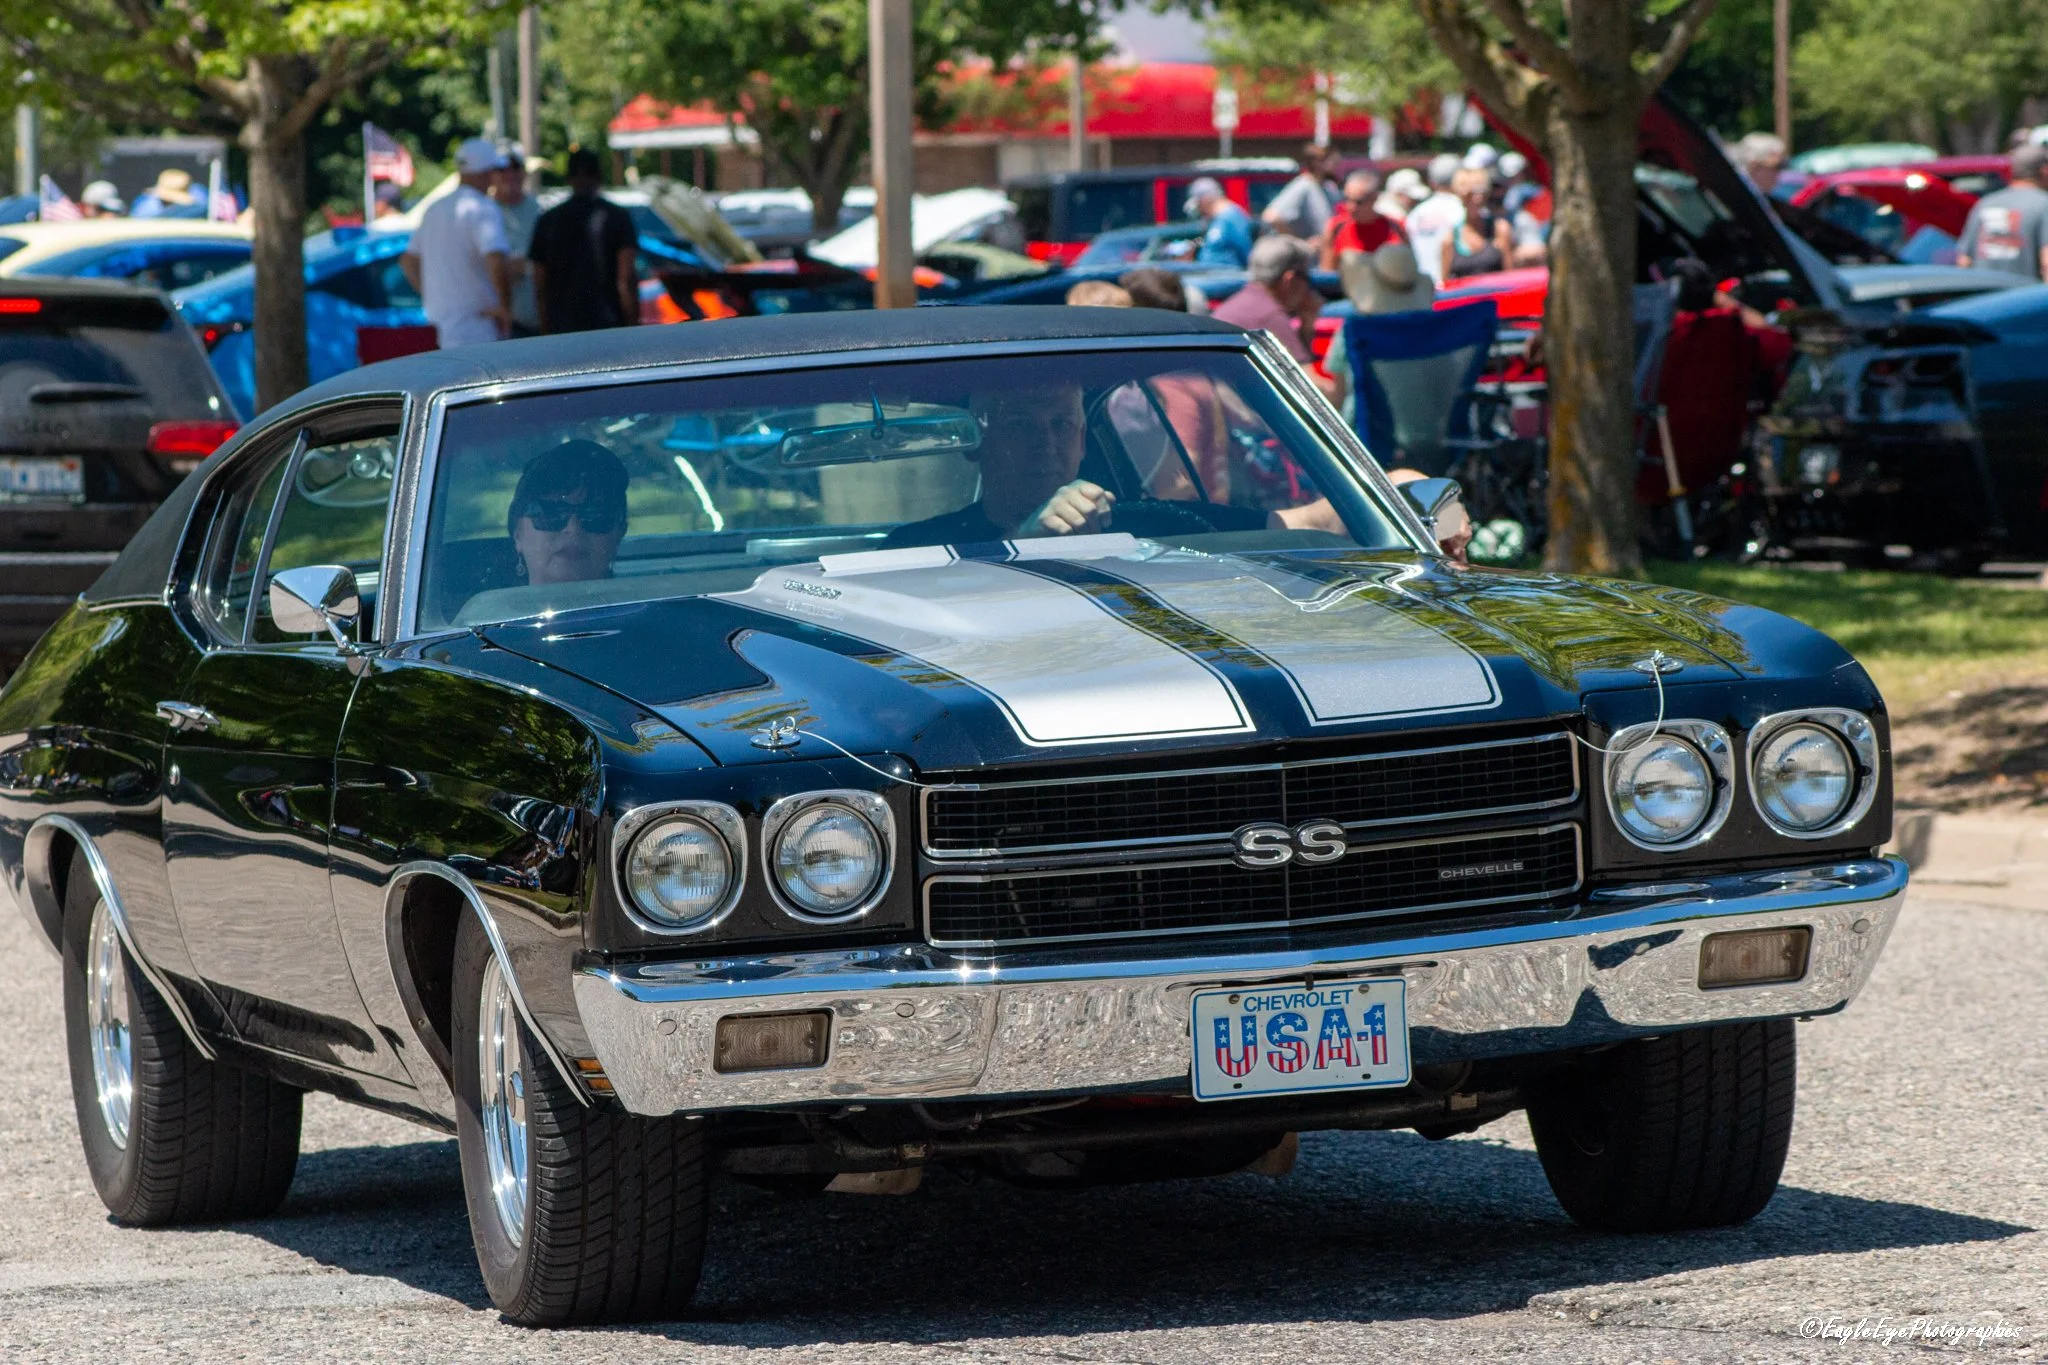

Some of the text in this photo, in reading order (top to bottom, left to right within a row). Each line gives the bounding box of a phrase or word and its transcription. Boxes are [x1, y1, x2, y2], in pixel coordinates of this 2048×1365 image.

[1239, 826, 1346, 865] SS
[1440, 862, 1524, 879] CHEVELLE
[1244, 990, 1353, 1012] CHEVROLET
[1214, 1005, 1388, 1077] USA-1
